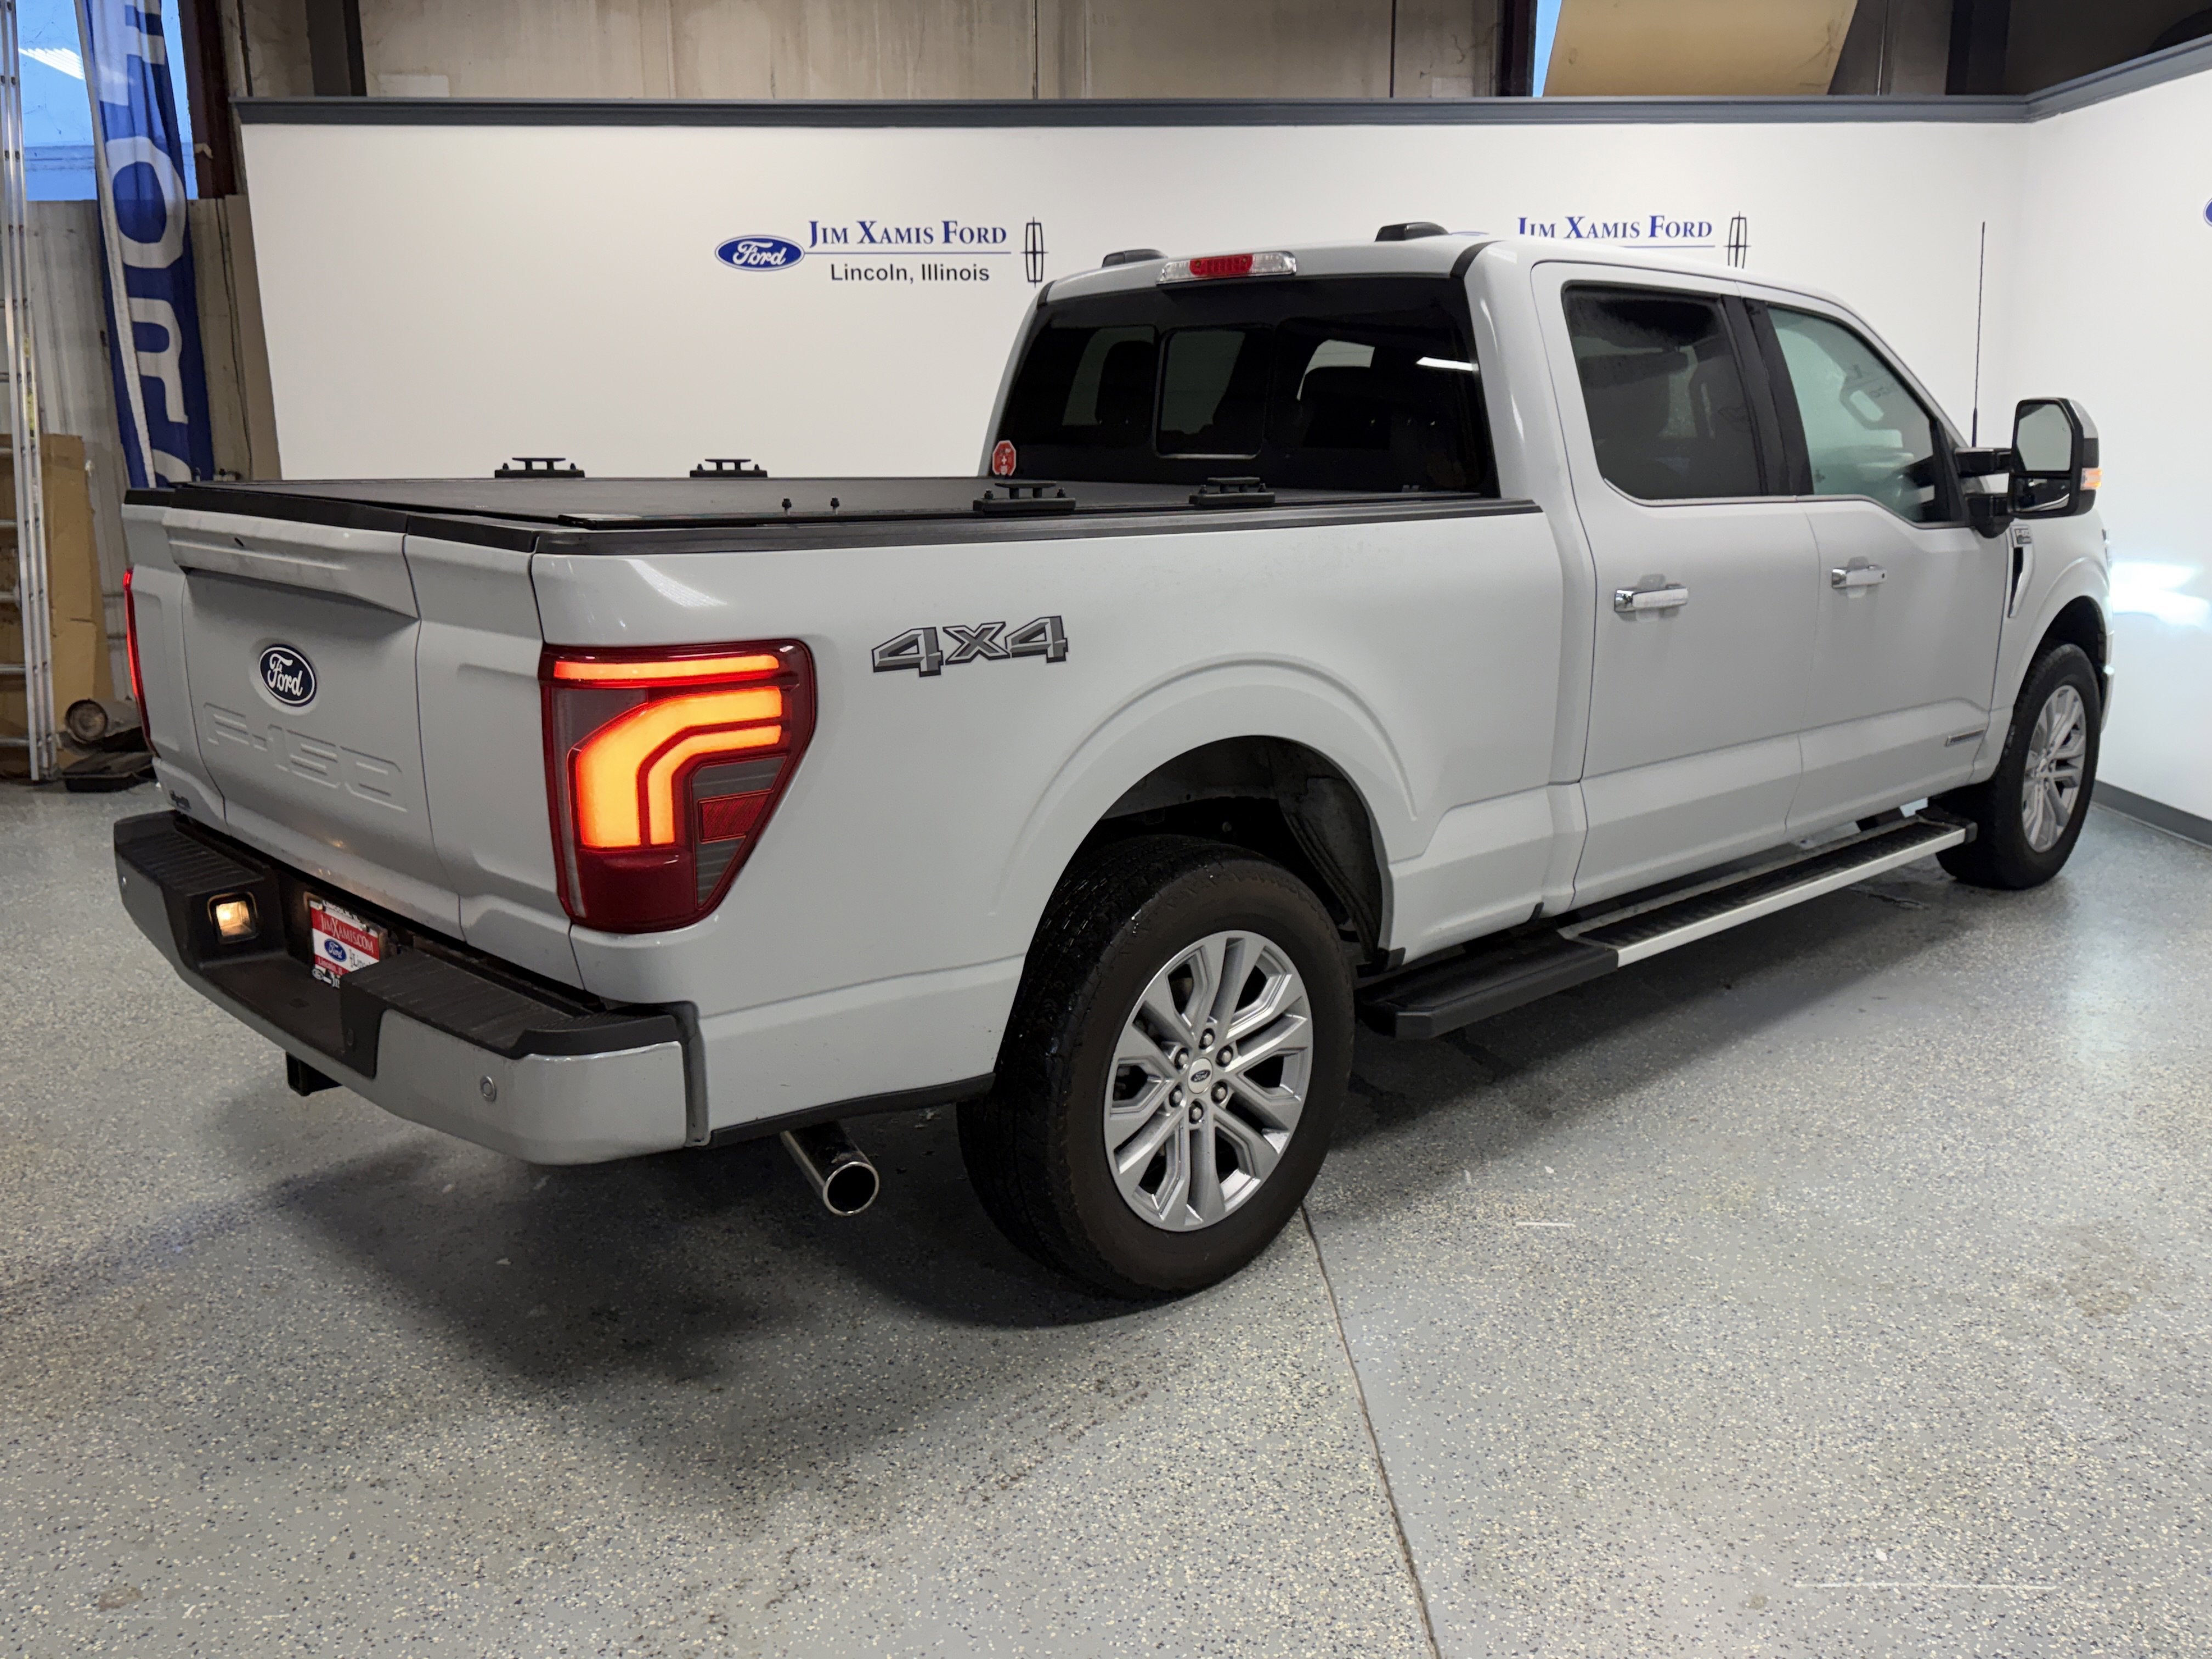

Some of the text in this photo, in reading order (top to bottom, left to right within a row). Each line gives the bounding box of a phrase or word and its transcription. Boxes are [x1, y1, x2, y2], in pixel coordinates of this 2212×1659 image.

[809, 221, 1007, 248] JIM XAMIS FORD
[1564, 216, 1640, 239] XAMIS
[1648, 216, 1712, 238] FORD
[92, 0, 192, 483] FOR
[732, 242, 787, 266] Ford
[831, 264, 990, 283] Lincoln, Illinois
[268, 653, 303, 696] Ford
[329, 941, 343, 958] Ford
[1193, 1070, 1208, 1082] Ford
